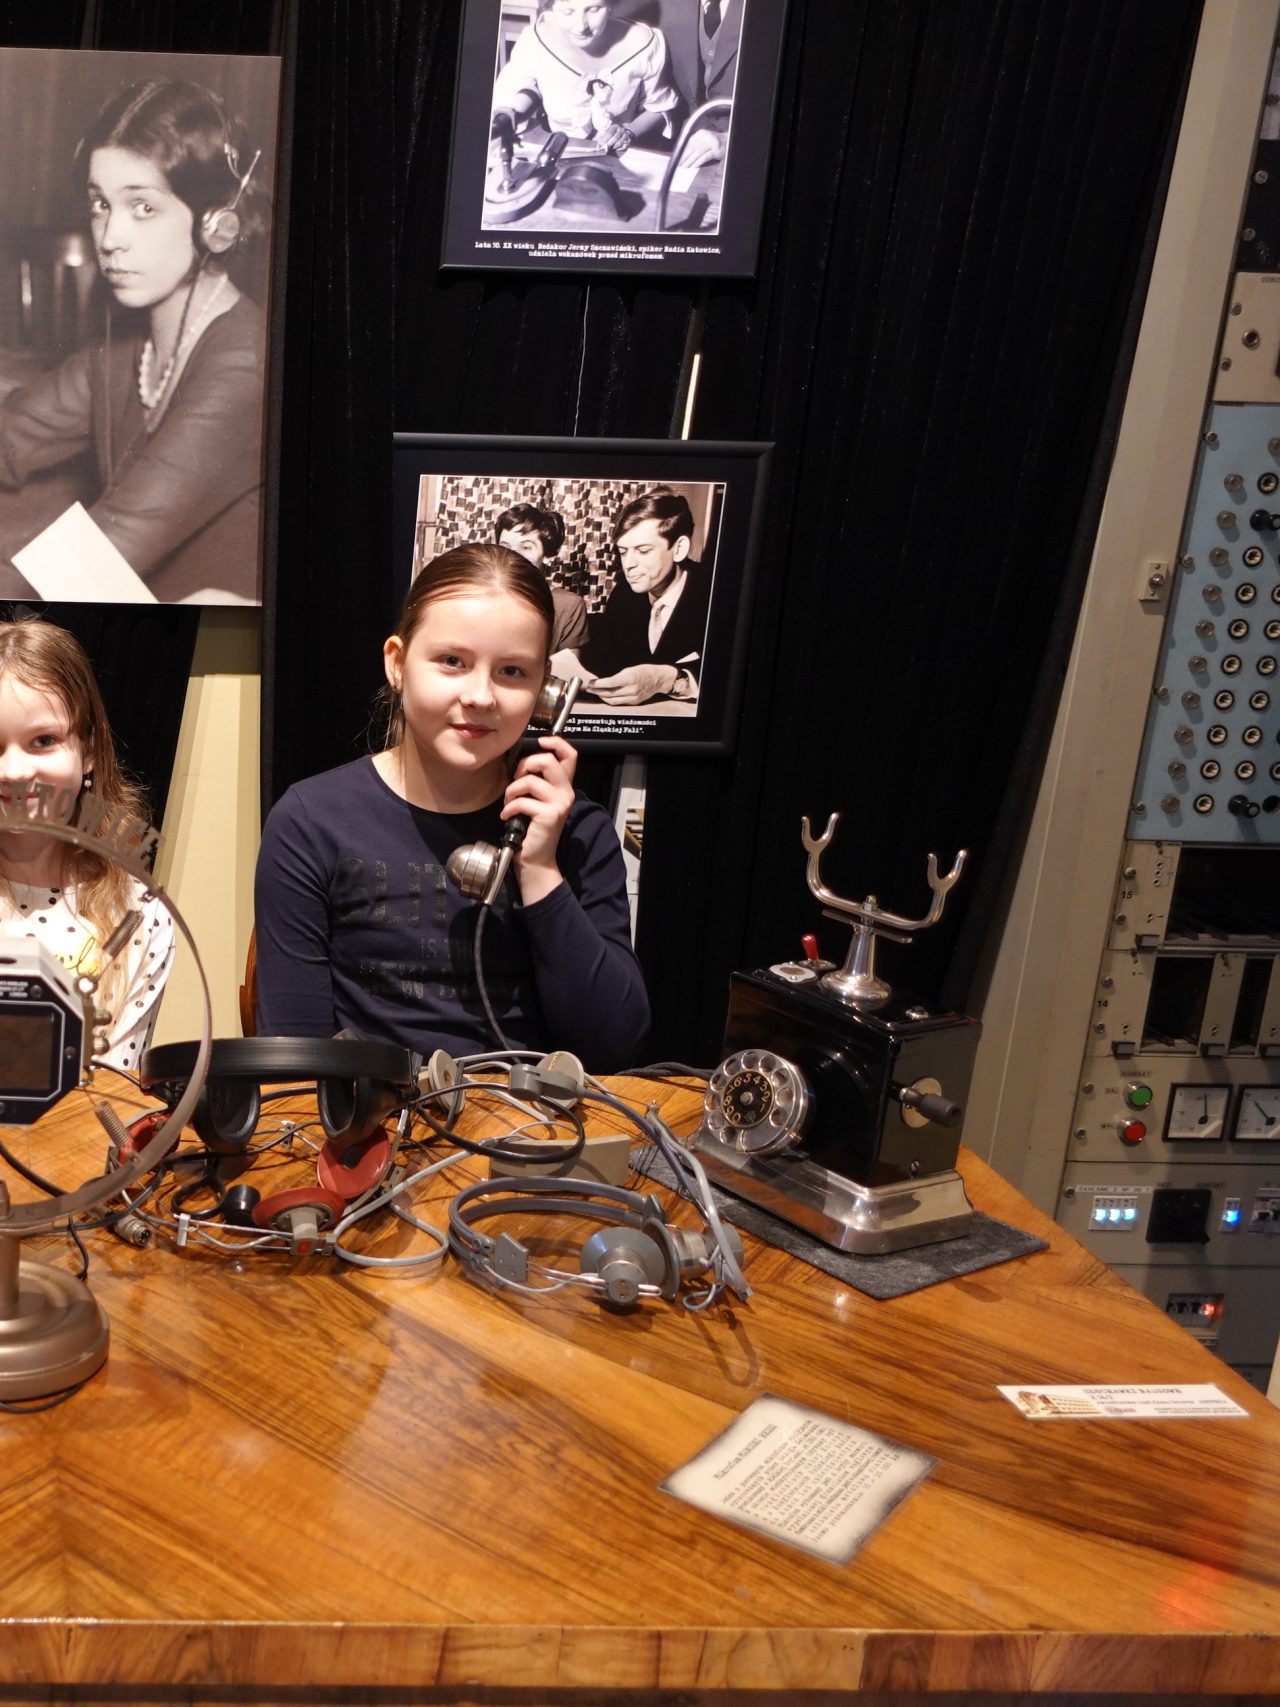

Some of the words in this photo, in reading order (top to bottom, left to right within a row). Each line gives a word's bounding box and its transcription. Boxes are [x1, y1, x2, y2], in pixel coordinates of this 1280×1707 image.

[1122, 891, 1133, 899] 15
[734, 1077, 742, 1087] 6
[743, 1073, 752, 1083] 5
[753, 1076, 761, 1085] 4
[726, 1085, 735, 1095] 7
[760, 1080, 768, 1091] 3
[723, 1095, 732, 1106] 8
[761, 1091, 770, 1102] 2
[726, 1105, 734, 1116] 9
[760, 1103, 766, 1112] 1
[732, 1112, 741, 1122] 0
